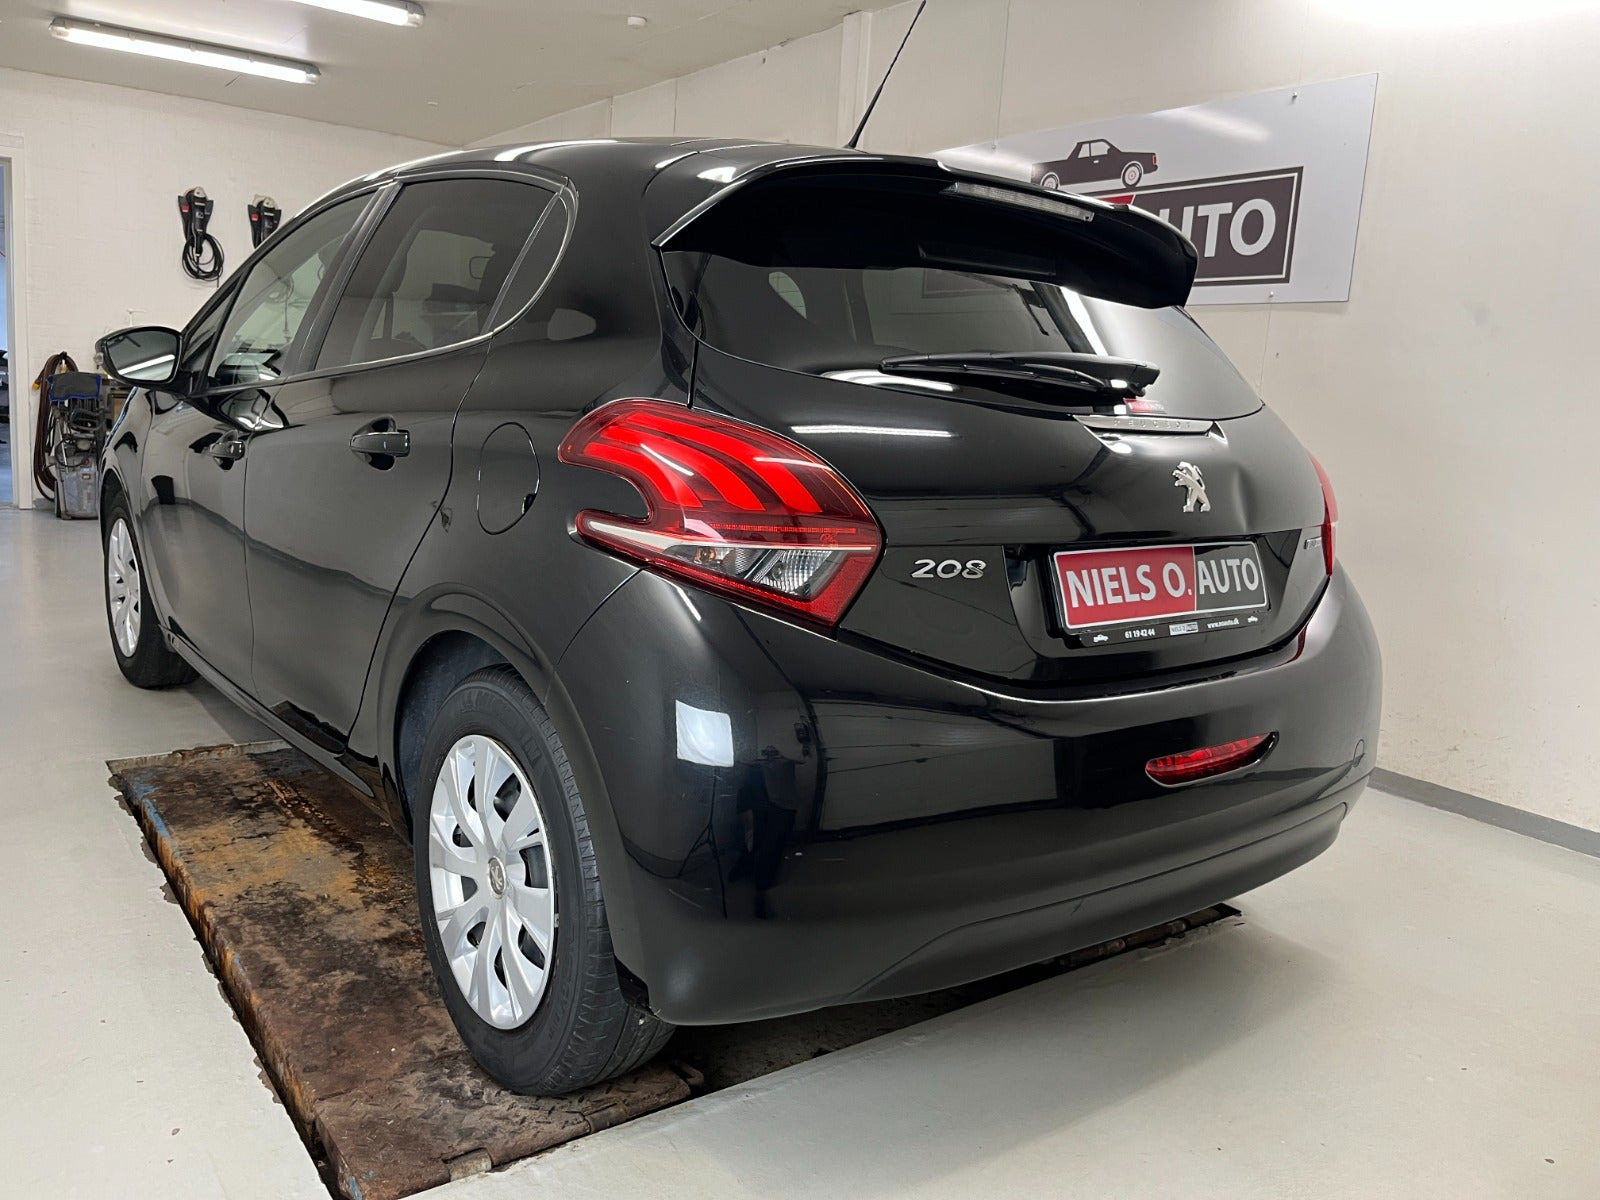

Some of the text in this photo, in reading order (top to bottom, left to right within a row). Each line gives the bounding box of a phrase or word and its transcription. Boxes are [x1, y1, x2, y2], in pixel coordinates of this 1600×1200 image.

[911, 558, 987, 579] 208
[1065, 557, 1259, 608] NIELS O. AUTO
